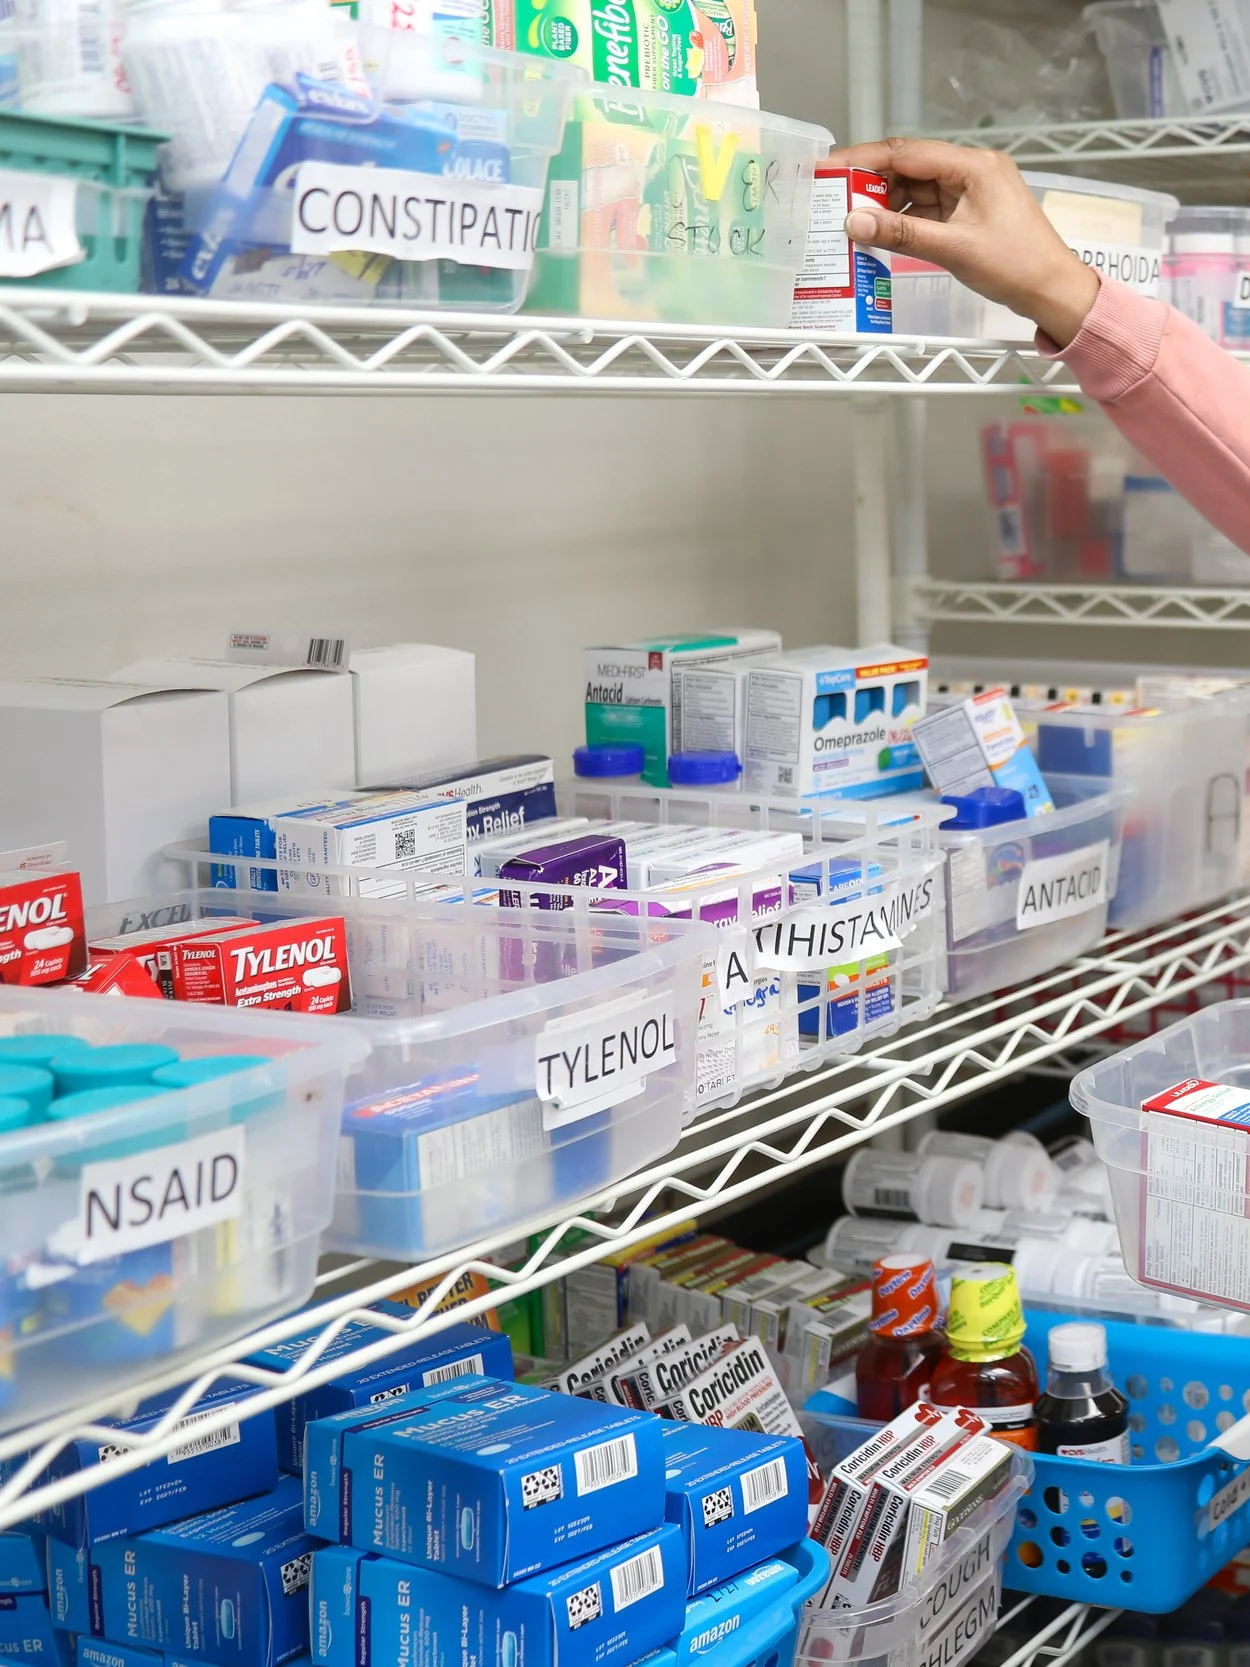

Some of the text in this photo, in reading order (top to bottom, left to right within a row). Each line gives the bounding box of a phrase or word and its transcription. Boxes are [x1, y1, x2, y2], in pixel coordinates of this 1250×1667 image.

[592, 0, 641, 123] Benefib
[643, 22, 651, 78] PREBIOTIC
[656, 15, 671, 90] on the GO
[865, 183, 884, 194] LEADER
[667, 221, 766, 257] STOCK
[597, 664, 646, 680] MEDI-FIRST
[585, 681, 623, 703] Antacid
[814, 726, 886, 752] Omeprazole
[483, 806, 525, 835] Relief
[1022, 866, 1102, 915] ANTACID
[0, 893, 67, 934] ENOL
[725, 878, 934, 990] ATIHISTAMINES
[34, 960, 45, 971] 24
[182, 950, 216, 961] TYLENOL
[230, 936, 336, 984] TYLENOL
[235, 980, 277, 997] Acetaminophen
[237, 985, 302, 1008] Extra Strength
[311, 995, 319, 1005] 24
[537, 1012, 676, 1096] TYLENOL
[86, 1153, 239, 1239] NSAID
[879, 1270, 912, 1298] Daytime
[894, 1306, 931, 1338] Daytime
[454, 1335, 492, 1351] TABLETS
[688, 1348, 766, 1419] Coricidin
[332, 1397, 405, 1422] amazon
[392, 1394, 529, 1438] Mucus ER
[758, 1439, 787, 1456] TABLETS
[840, 1430, 896, 1475] Coricidin HBP
[858, 1445, 902, 1480] MAXIMUM STRENGTH
[882, 1434, 936, 1479] Coricidin HBP
[900, 1449, 943, 1485] MAXIMUM STRENGTH
[309, 1471, 320, 1527] amazon
[372, 1453, 385, 1546] Mucus ER
[425, 1522, 433, 1560] Unique
[814, 1523, 822, 1533] FLU
[828, 1489, 862, 1556] Coricidin HBP
[855, 1529, 863, 1540] FLU
[870, 1495, 904, 1563] Coricidin HBP
[432, 1529, 440, 1562] Tablet
[125, 1550, 139, 1637] Mucus ER
[745, 1564, 785, 1587] amazon
[920, 1533, 991, 1630] COUGH
[55, 1568, 66, 1622] amazon
[184, 1615, 192, 1649] Unique
[319, 1600, 330, 1657] amazon
[398, 1580, 410, 1667] Mucus ER
[461, 1604, 469, 1648] Bi-Layer
[689, 1613, 741, 1654] amazon
[919, 1584, 996, 1667] HLEGM
[23, 1638, 44, 1653] ER
[83, 1647, 125, 1667] amazon
